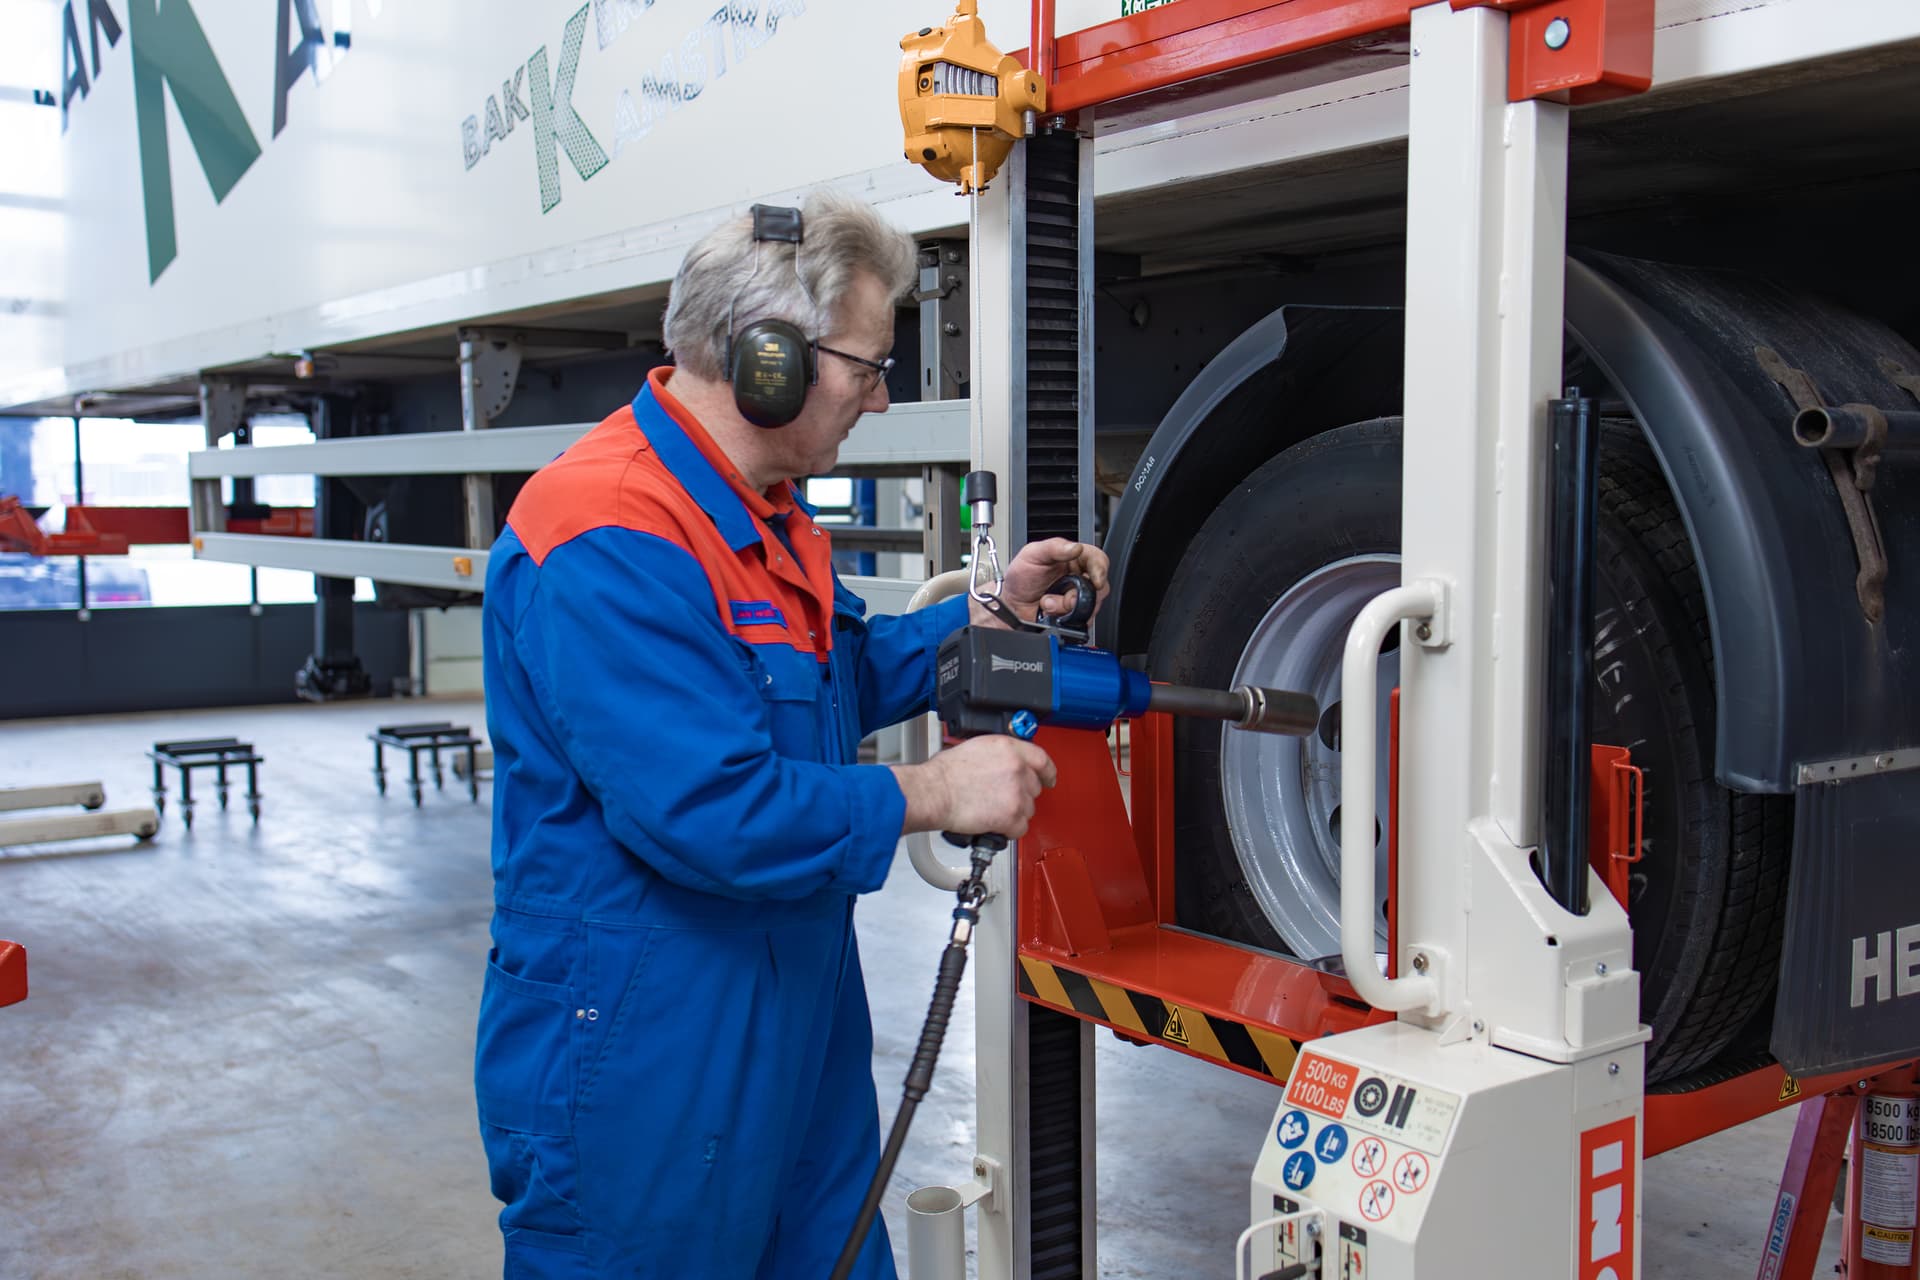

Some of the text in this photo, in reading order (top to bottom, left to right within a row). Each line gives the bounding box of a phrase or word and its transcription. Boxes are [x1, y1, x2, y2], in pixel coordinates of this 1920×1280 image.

[1134, 456, 1156, 492] DOMAR
[941, 665, 960, 685] ITALY
[1014, 661, 1043, 673] paoli
[1305, 1059, 1348, 1089] 500 KG
[1293, 1081, 1345, 1113] 1100 LBS
[1866, 1099, 1901, 1118] 8500
[1865, 1121, 1903, 1140] 18500
[1770, 1197, 1792, 1254] stertil
[1876, 1231, 1910, 1240] CAUTION
